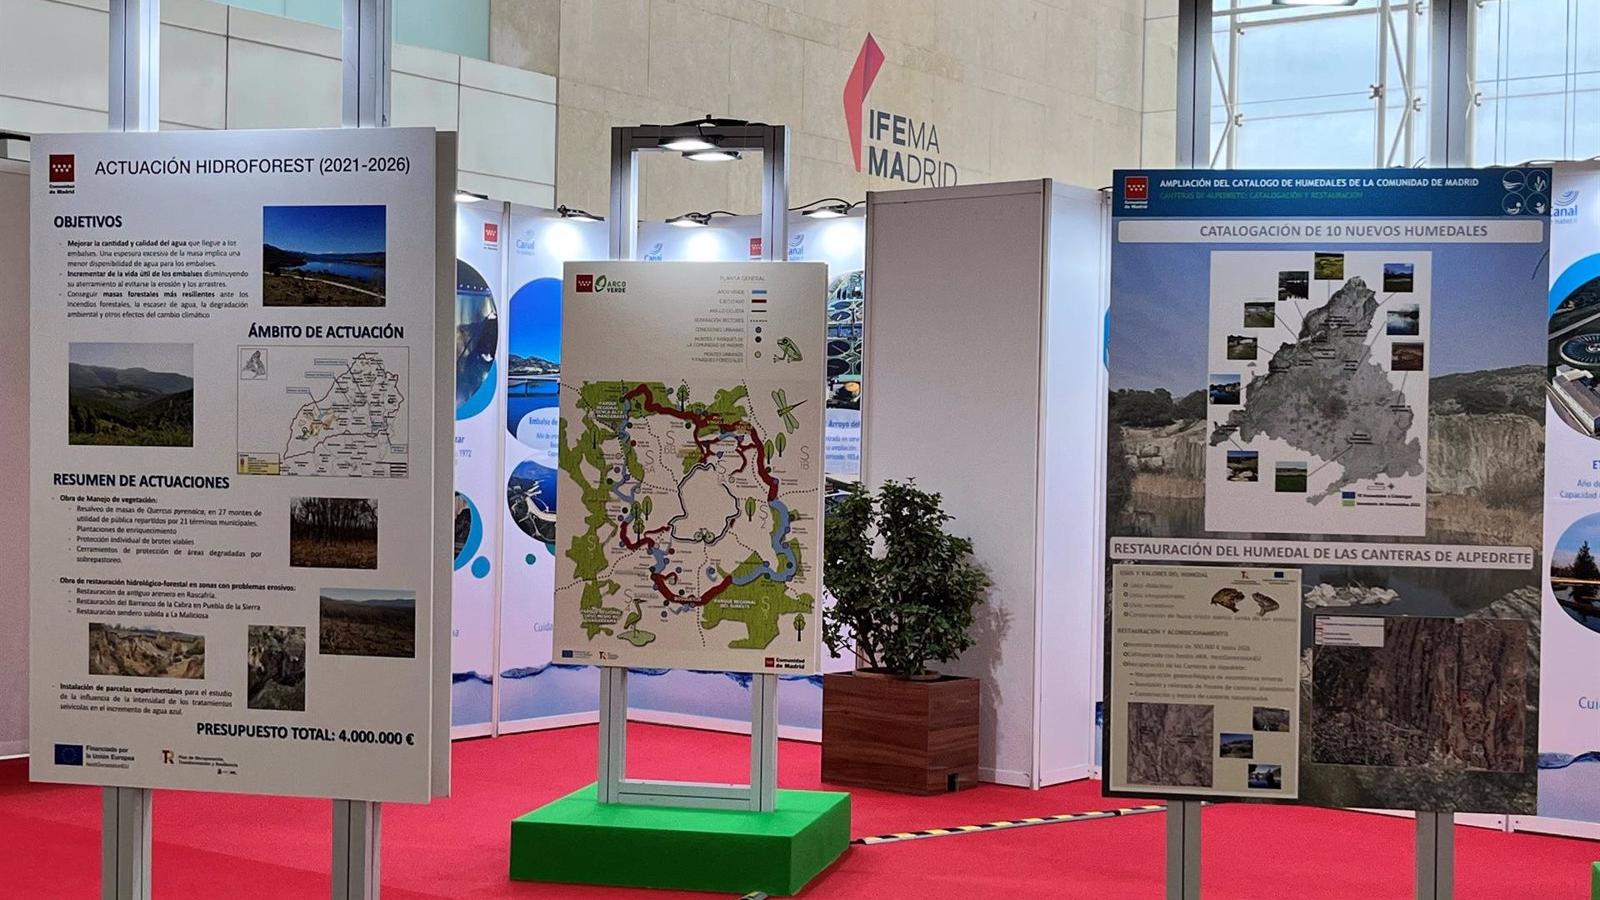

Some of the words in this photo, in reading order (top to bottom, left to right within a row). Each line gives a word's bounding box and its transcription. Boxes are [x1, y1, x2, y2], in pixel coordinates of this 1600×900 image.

[870, 109, 940, 154] IFEMA
[95, 157, 190, 174] ACTUACIÓN
[196, 157, 314, 174] HIDROFOREST
[319, 157, 410, 174] (2021-2026)
[869, 146, 957, 188] MADRID
[1160, 178, 1211, 187] AMPLIACIÓN
[1232, 179, 1278, 187] CATALOGO
[1295, 179, 1347, 187] HUMEDALES
[1363, 179, 1374, 187] LA
[1376, 179, 1429, 187] COMUNIDAD
[1444, 179, 1479, 187] MADRID
[1550, 205, 1578, 216] anal
[53, 216, 122, 229] OBJETIVOS
[1200, 224, 1300, 236] CATALOGACIÓN
[1305, 226, 1321, 236] DE
[1328, 226, 1341, 236] 10
[1346, 226, 1400, 236] NUEVOS
[1405, 226, 1488, 236] HUMEDALES
[67, 240, 93, 248] Mejorar
[201, 240, 221, 248] llegue
[248, 323, 302, 338] ÁMBITO
[306, 324, 322, 338] DE
[326, 323, 404, 338] ACTUACIÓN
[828, 420, 850, 429] Arroyo
[54, 473, 116, 486] RESUMEN
[120, 474, 136, 487] DE
[139, 475, 230, 488] ACTUACIONES
[86, 495, 110, 504] Manejo
[122, 496, 158, 505] vegetación:
[1560, 490, 1597, 499] Capacidad
[111, 517, 132, 525] pública
[134, 517, 166, 526] repartidos
[219, 519, 258, 528] municipales.
[126, 527, 177, 536] enriquecimiento
[136, 547, 169, 556] protección
[209, 549, 246, 558] degradadas
[1114, 543, 1211, 556] RESTAURACIÓN
[1216, 546, 1239, 557] DEL
[1244, 547, 1310, 559] HUMEDAL
[1314, 548, 1330, 559] DE
[1334, 549, 1357, 560] LAS
[1362, 550, 1430, 561] CANTERAS
[1435, 551, 1451, 562] DE
[1456, 552, 1531, 564] ALPEDRETE
[126, 580, 188, 589] hidrológico-forestal
[232, 583, 265, 592] problemas
[127, 590, 150, 598] antiguo
[60, 683, 94, 691] Instalación
[106, 685, 132, 694] parcelas
[134, 686, 183, 696] experimentales
[197, 723, 288, 739] PRESUPUESTO
[293, 727, 335, 741] TOTAL:
[339, 730, 402, 744] 4.000.000
[406, 732, 414, 745] €
